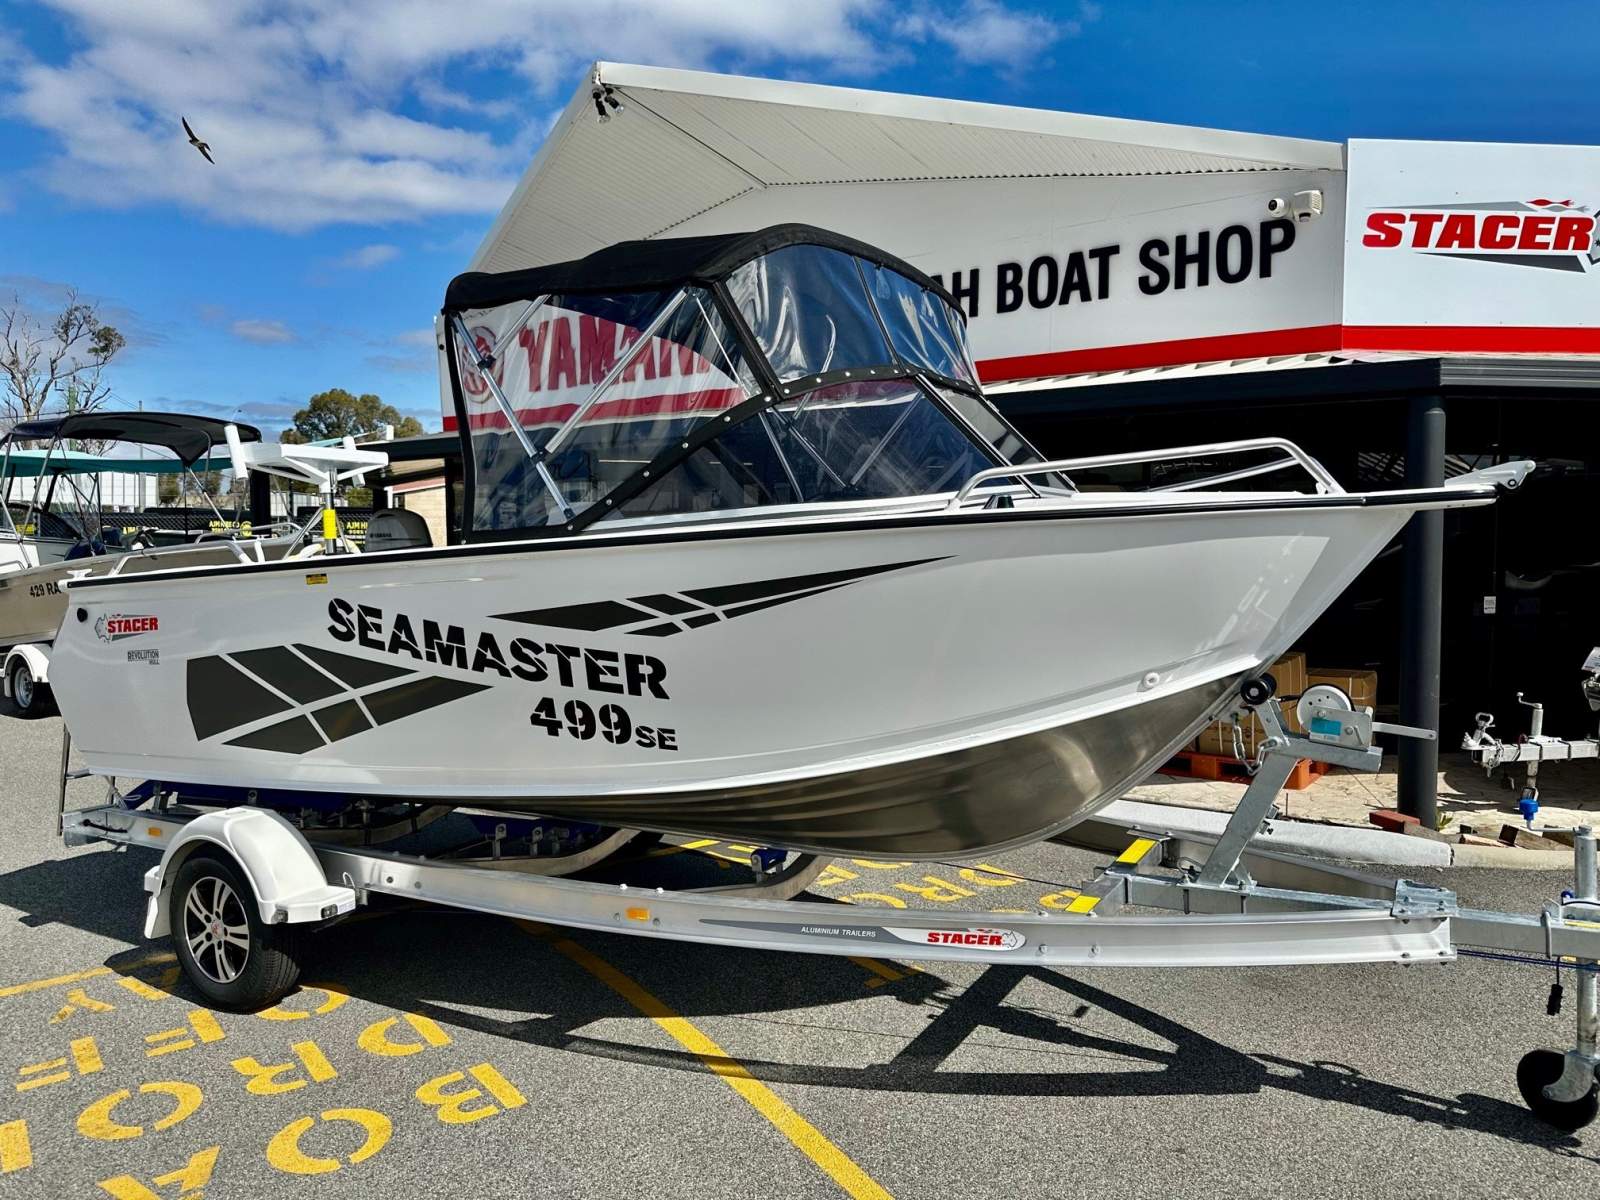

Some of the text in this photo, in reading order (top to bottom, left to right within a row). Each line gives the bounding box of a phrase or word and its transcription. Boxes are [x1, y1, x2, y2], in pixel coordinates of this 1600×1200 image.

[1362, 212, 1594, 251] STACER
[997, 245, 1120, 314] BOAT
[1138, 218, 1296, 297] SHOP
[108, 617, 159, 634] STACER
[127, 649, 160, 661] REVOLUTION
[328, 598, 670, 699] SEAMASTER
[801, 926, 1003, 946] ALUMINIUM TRAILERS STACER
